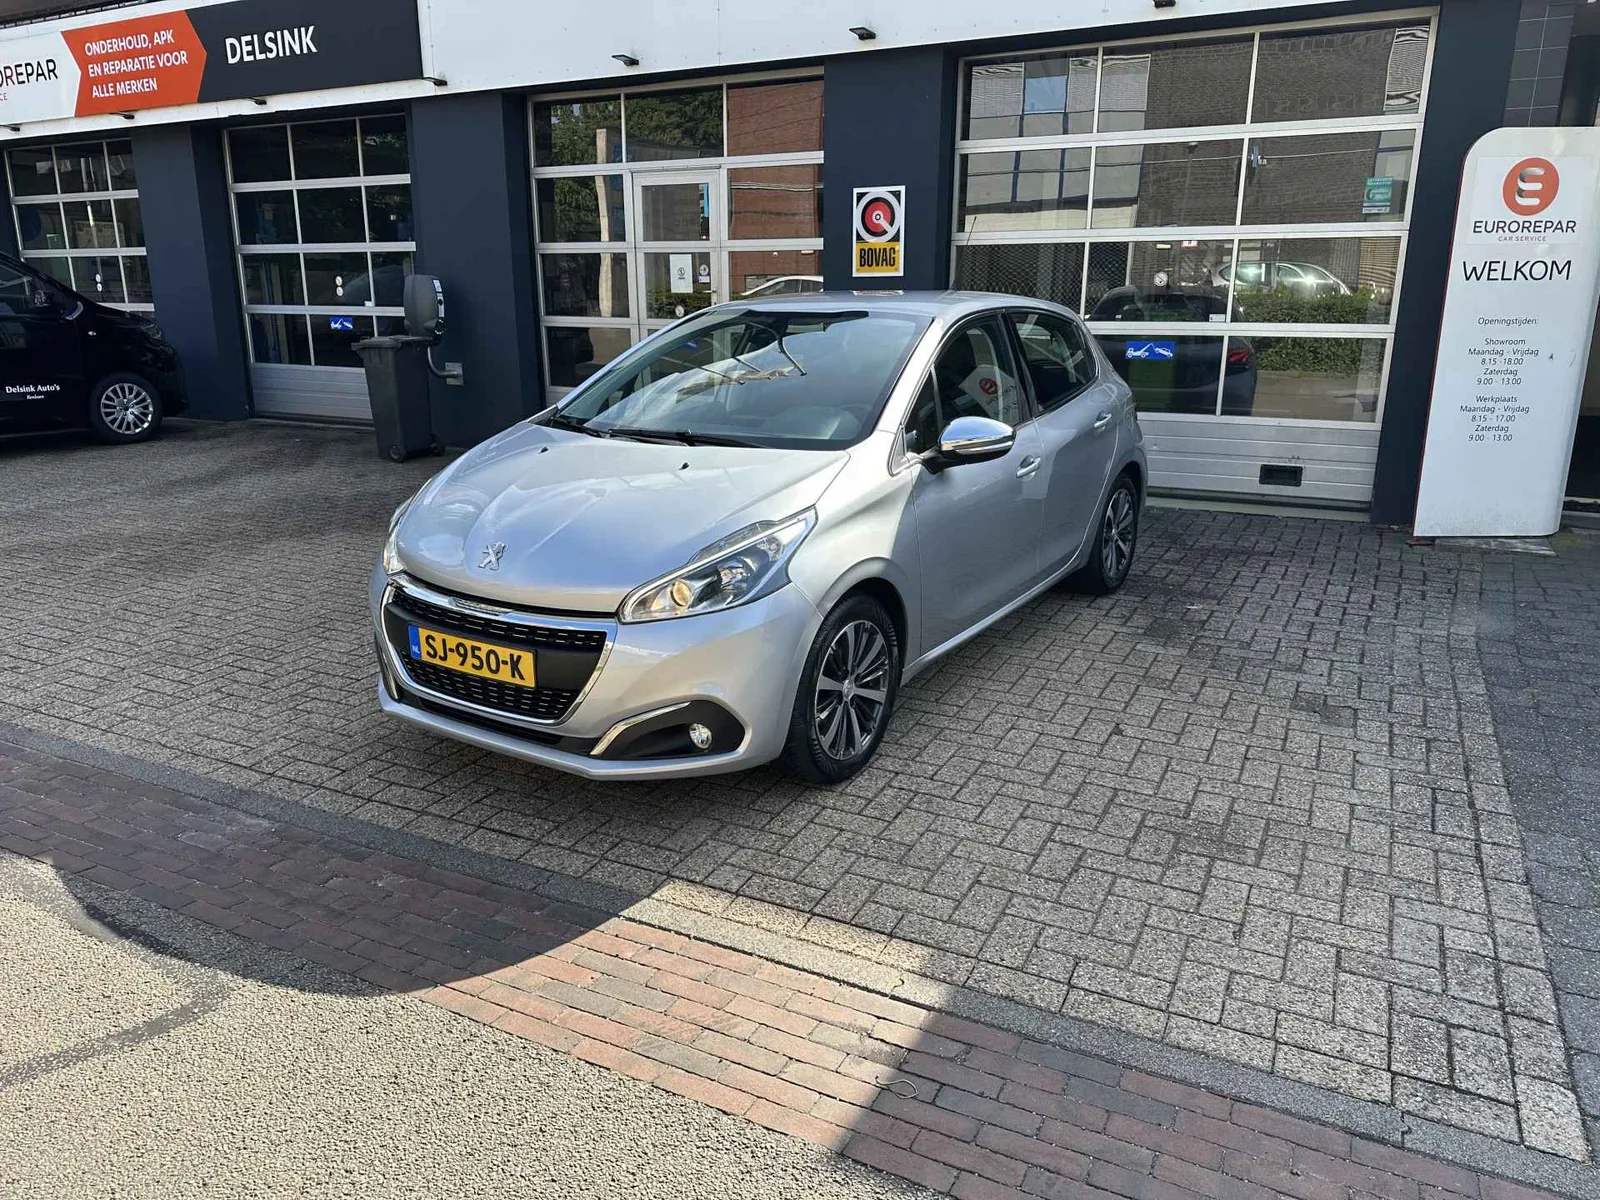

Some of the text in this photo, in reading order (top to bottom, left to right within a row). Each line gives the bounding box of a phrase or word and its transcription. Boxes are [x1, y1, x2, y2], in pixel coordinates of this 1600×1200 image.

[84, 29, 175, 56] ONDERHOUD, APK
[224, 25, 318, 65] DELSINK
[88, 50, 189, 77] EN REPARATIE VOOR
[92, 77, 158, 98] ALLE MERKEN
[1473, 220, 1577, 234] EUROREPAR
[859, 247, 896, 267] BOVAG
[1463, 260, 1572, 281] WELKOM
[1484, 337, 1526, 346] Showroom
[1468, 347, 1504, 357] Maandag
[1512, 347, 1539, 357] Vrijdag
[1483, 367, 1518, 377] Zaterdag
[5, 384, 60, 393] Delsink Auto's
[1475, 395, 1518, 404] Werkplaats
[1459, 405, 1496, 414] Maandag
[1503, 405, 1530, 414] Vrijdag
[1474, 424, 1509, 433] Zaterdag
[425, 634, 525, 681] SJ-950-K
